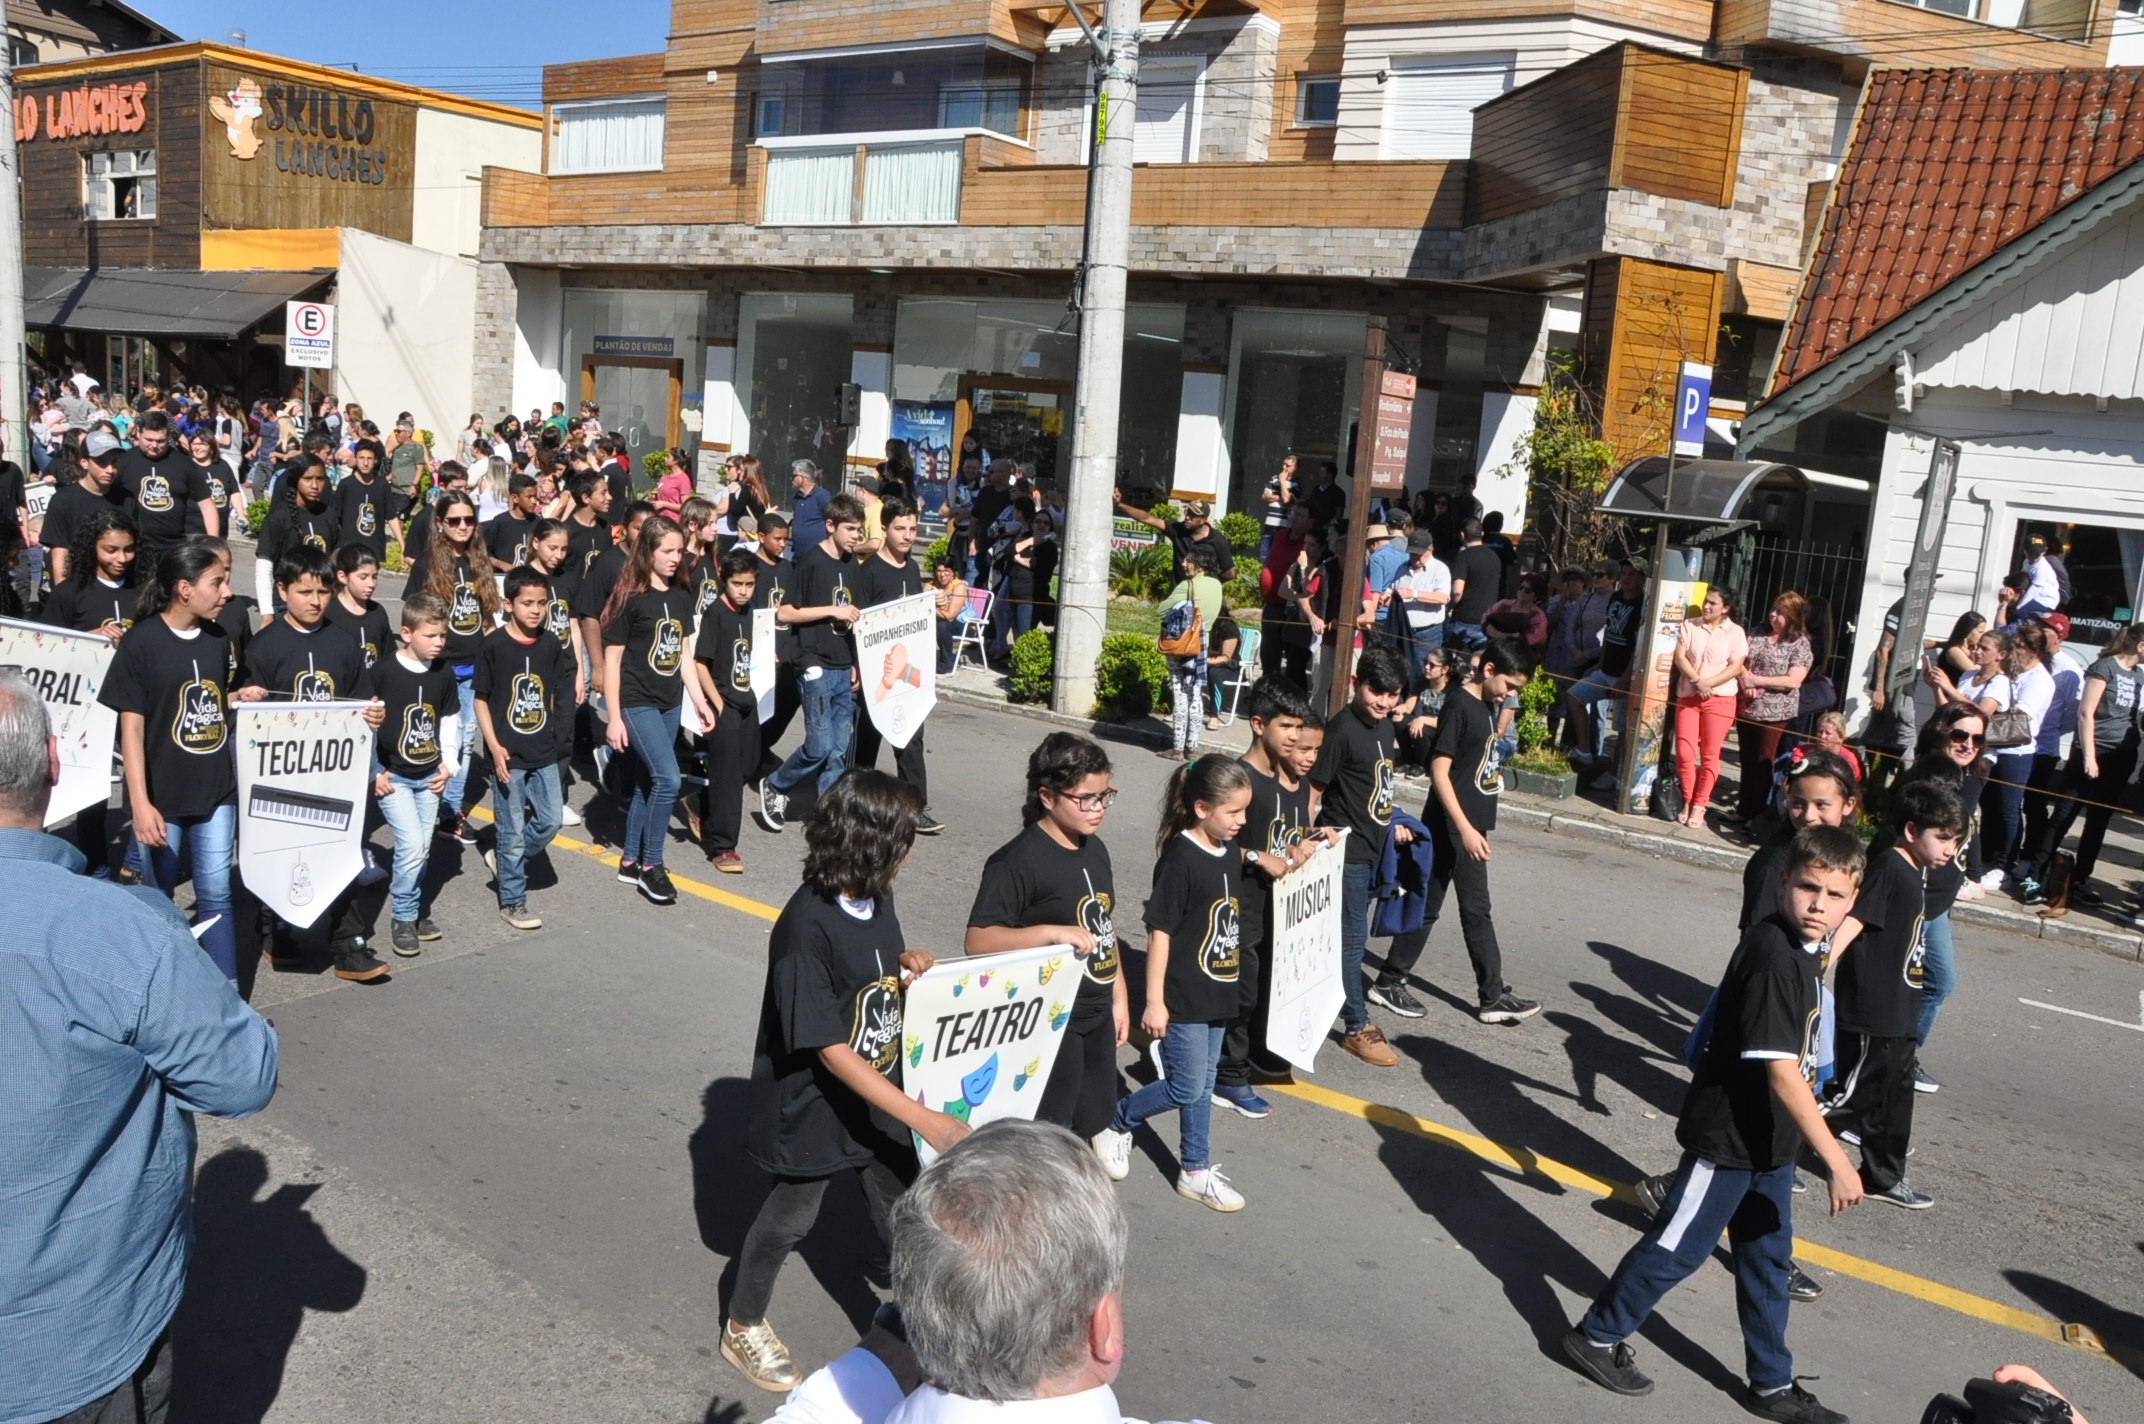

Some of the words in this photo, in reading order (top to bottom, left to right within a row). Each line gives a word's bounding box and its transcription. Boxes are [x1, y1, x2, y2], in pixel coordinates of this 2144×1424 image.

[46, 80, 148, 139] LANCHES
[266, 82, 375, 145] SKILLO
[275, 136, 386, 185] LANCHES
[304, 310, 318, 331] E
[290, 338, 310, 346] ZONA
[291, 348, 329, 356] EXCLUSIVO
[595, 340, 630, 351] PLANTÃO
[631, 342, 642, 351] DE
[642, 342, 673, 352] VENDAS
[1683, 387, 1700, 430] P
[1114, 521, 1152, 531] realiz
[863, 618, 928, 648] COMPANHEIRISMO
[2070, 616, 2121, 630] IMATIZADO
[25, 667, 83, 706] ORAL
[306, 680, 331, 701] Vida
[192, 690, 218, 714] Vida
[184, 711, 224, 734] Mágica
[256, 737, 354, 777] TECLADO
[1285, 874, 1331, 931] MÚSICA
[1222, 909, 1240, 938] Vida
[872, 991, 899, 1030] Vida
[863, 1020, 903, 1059] Mágica
[933, 996, 1044, 1063] TEATRO
